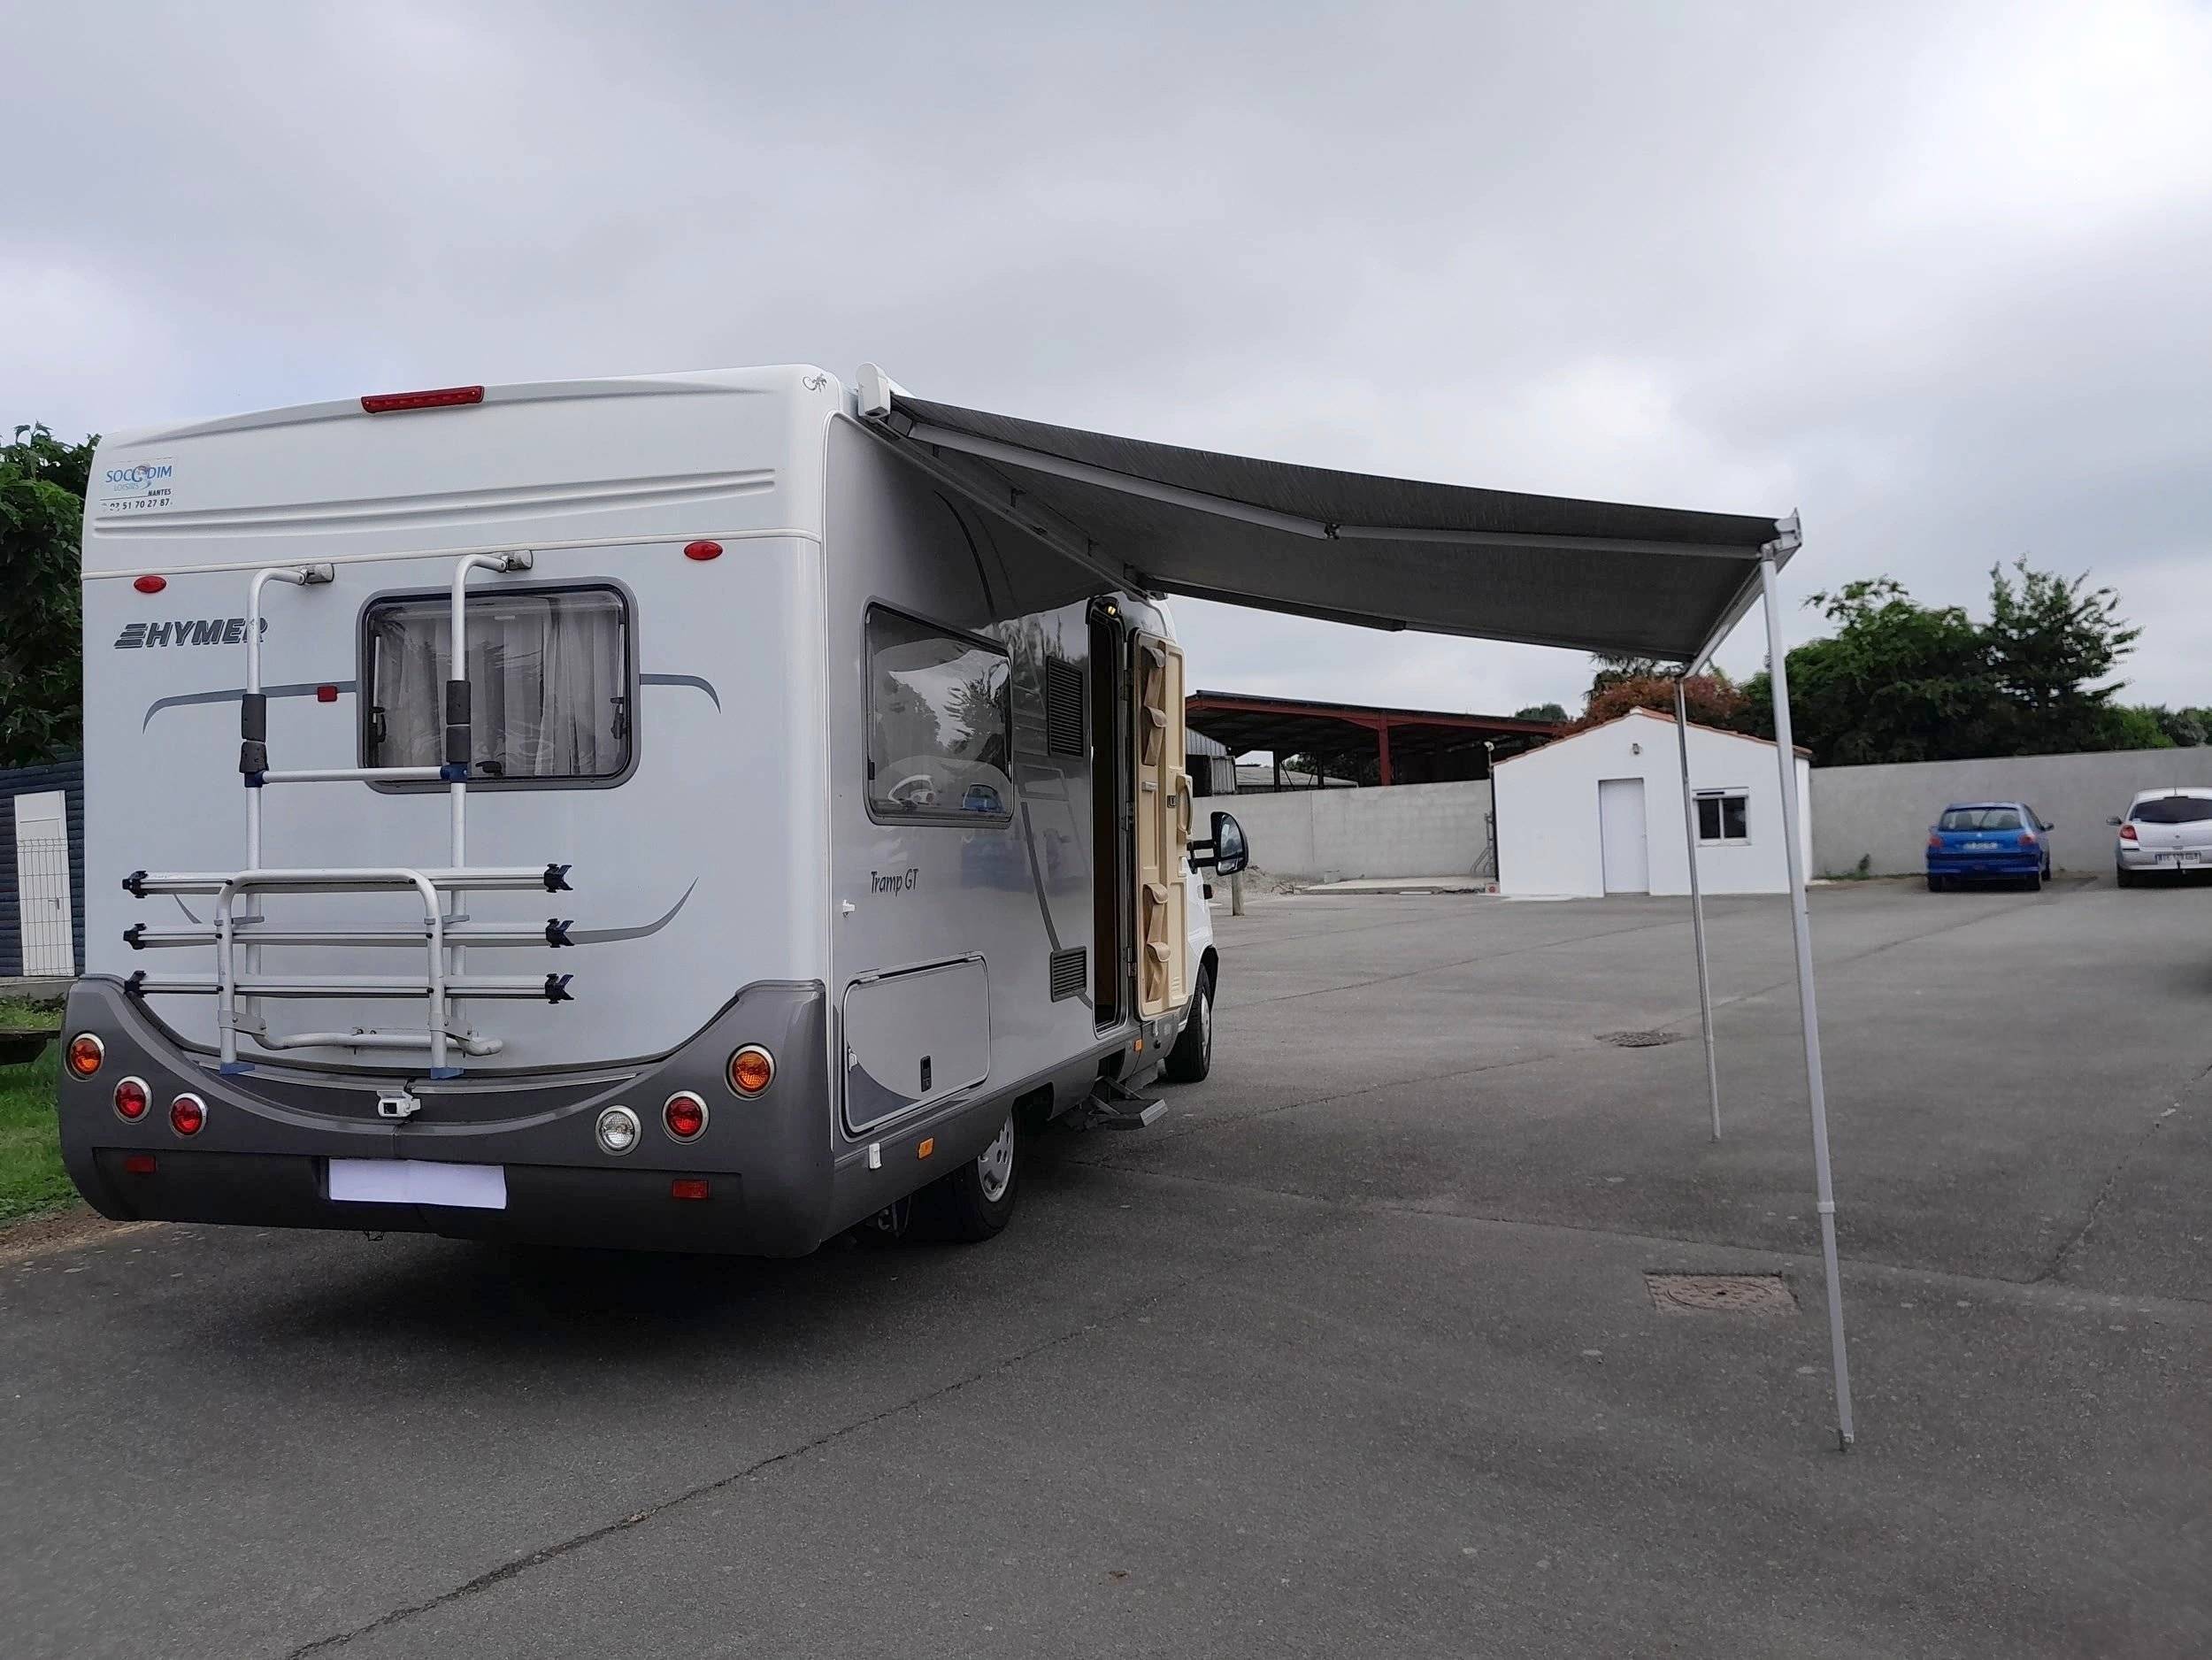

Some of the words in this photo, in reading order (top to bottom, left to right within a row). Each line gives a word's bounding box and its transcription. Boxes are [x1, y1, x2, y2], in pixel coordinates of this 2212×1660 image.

[122, 502, 132, 511] 51
[134, 500, 145, 509] 70
[147, 499, 157, 508] 27
[159, 498, 170, 507] 87
[871, 871, 902, 897] Tramp
[904, 868, 918, 890] GT
